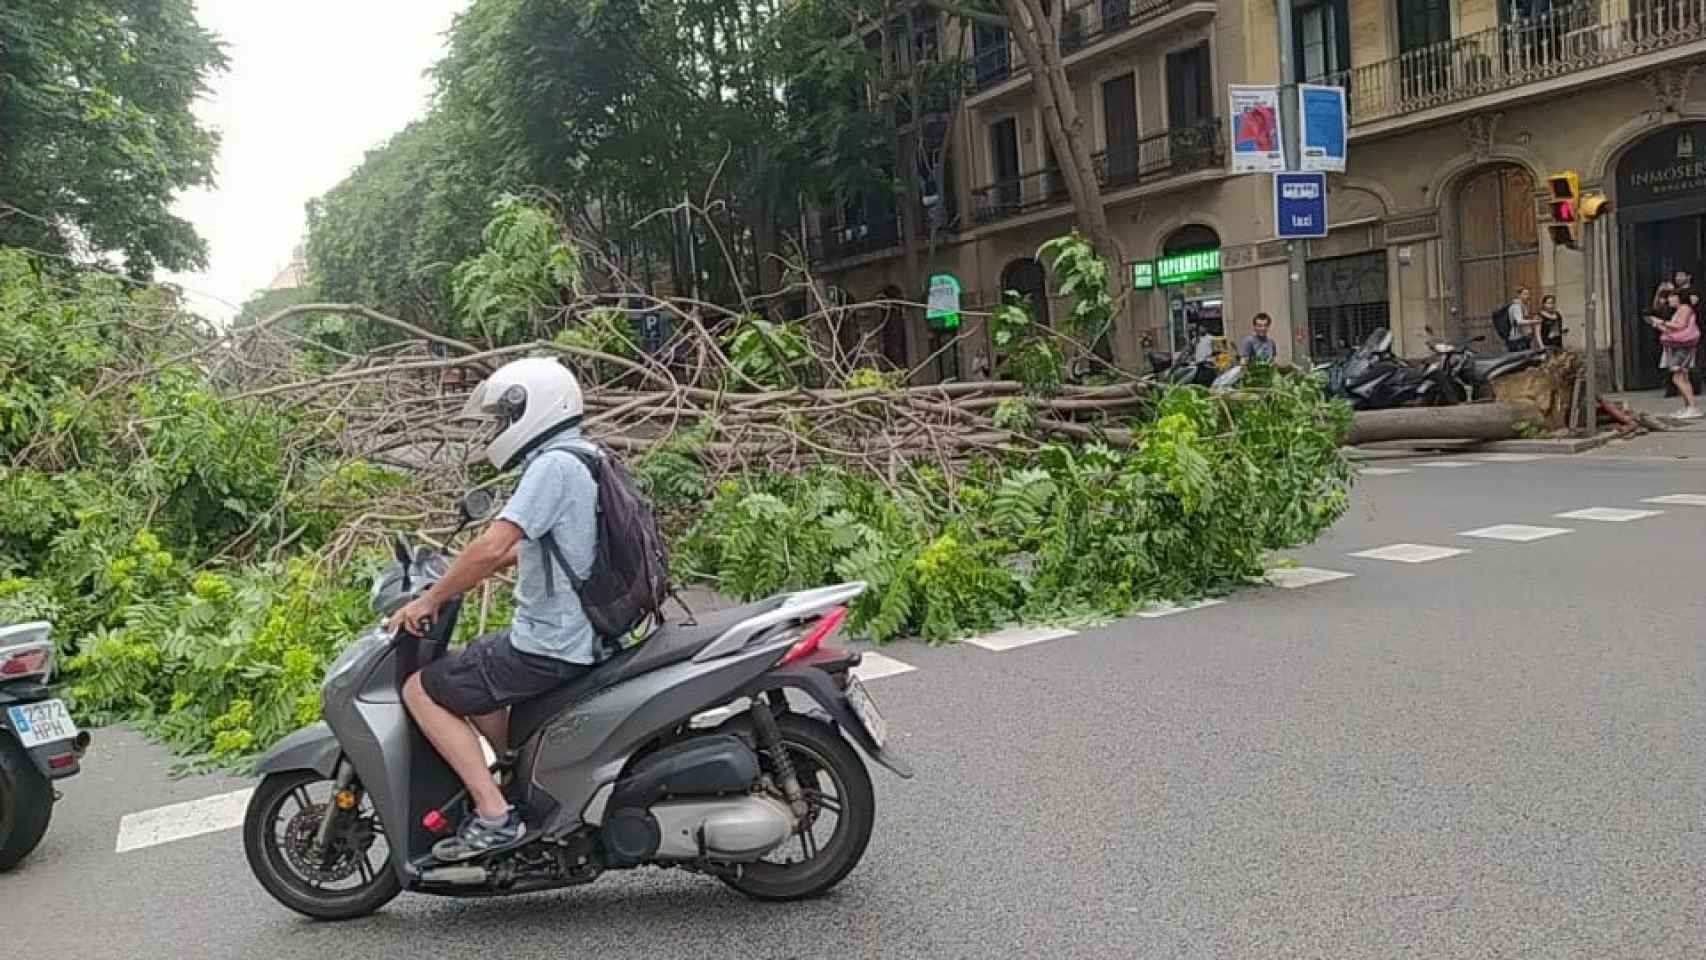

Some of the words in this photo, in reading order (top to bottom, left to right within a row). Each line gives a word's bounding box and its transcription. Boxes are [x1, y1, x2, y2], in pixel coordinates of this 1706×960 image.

[1292, 214, 1312, 227] taxi
[646, 315, 657, 330] P
[25, 702, 66, 724] 2372
[33, 721, 65, 741] HPH
